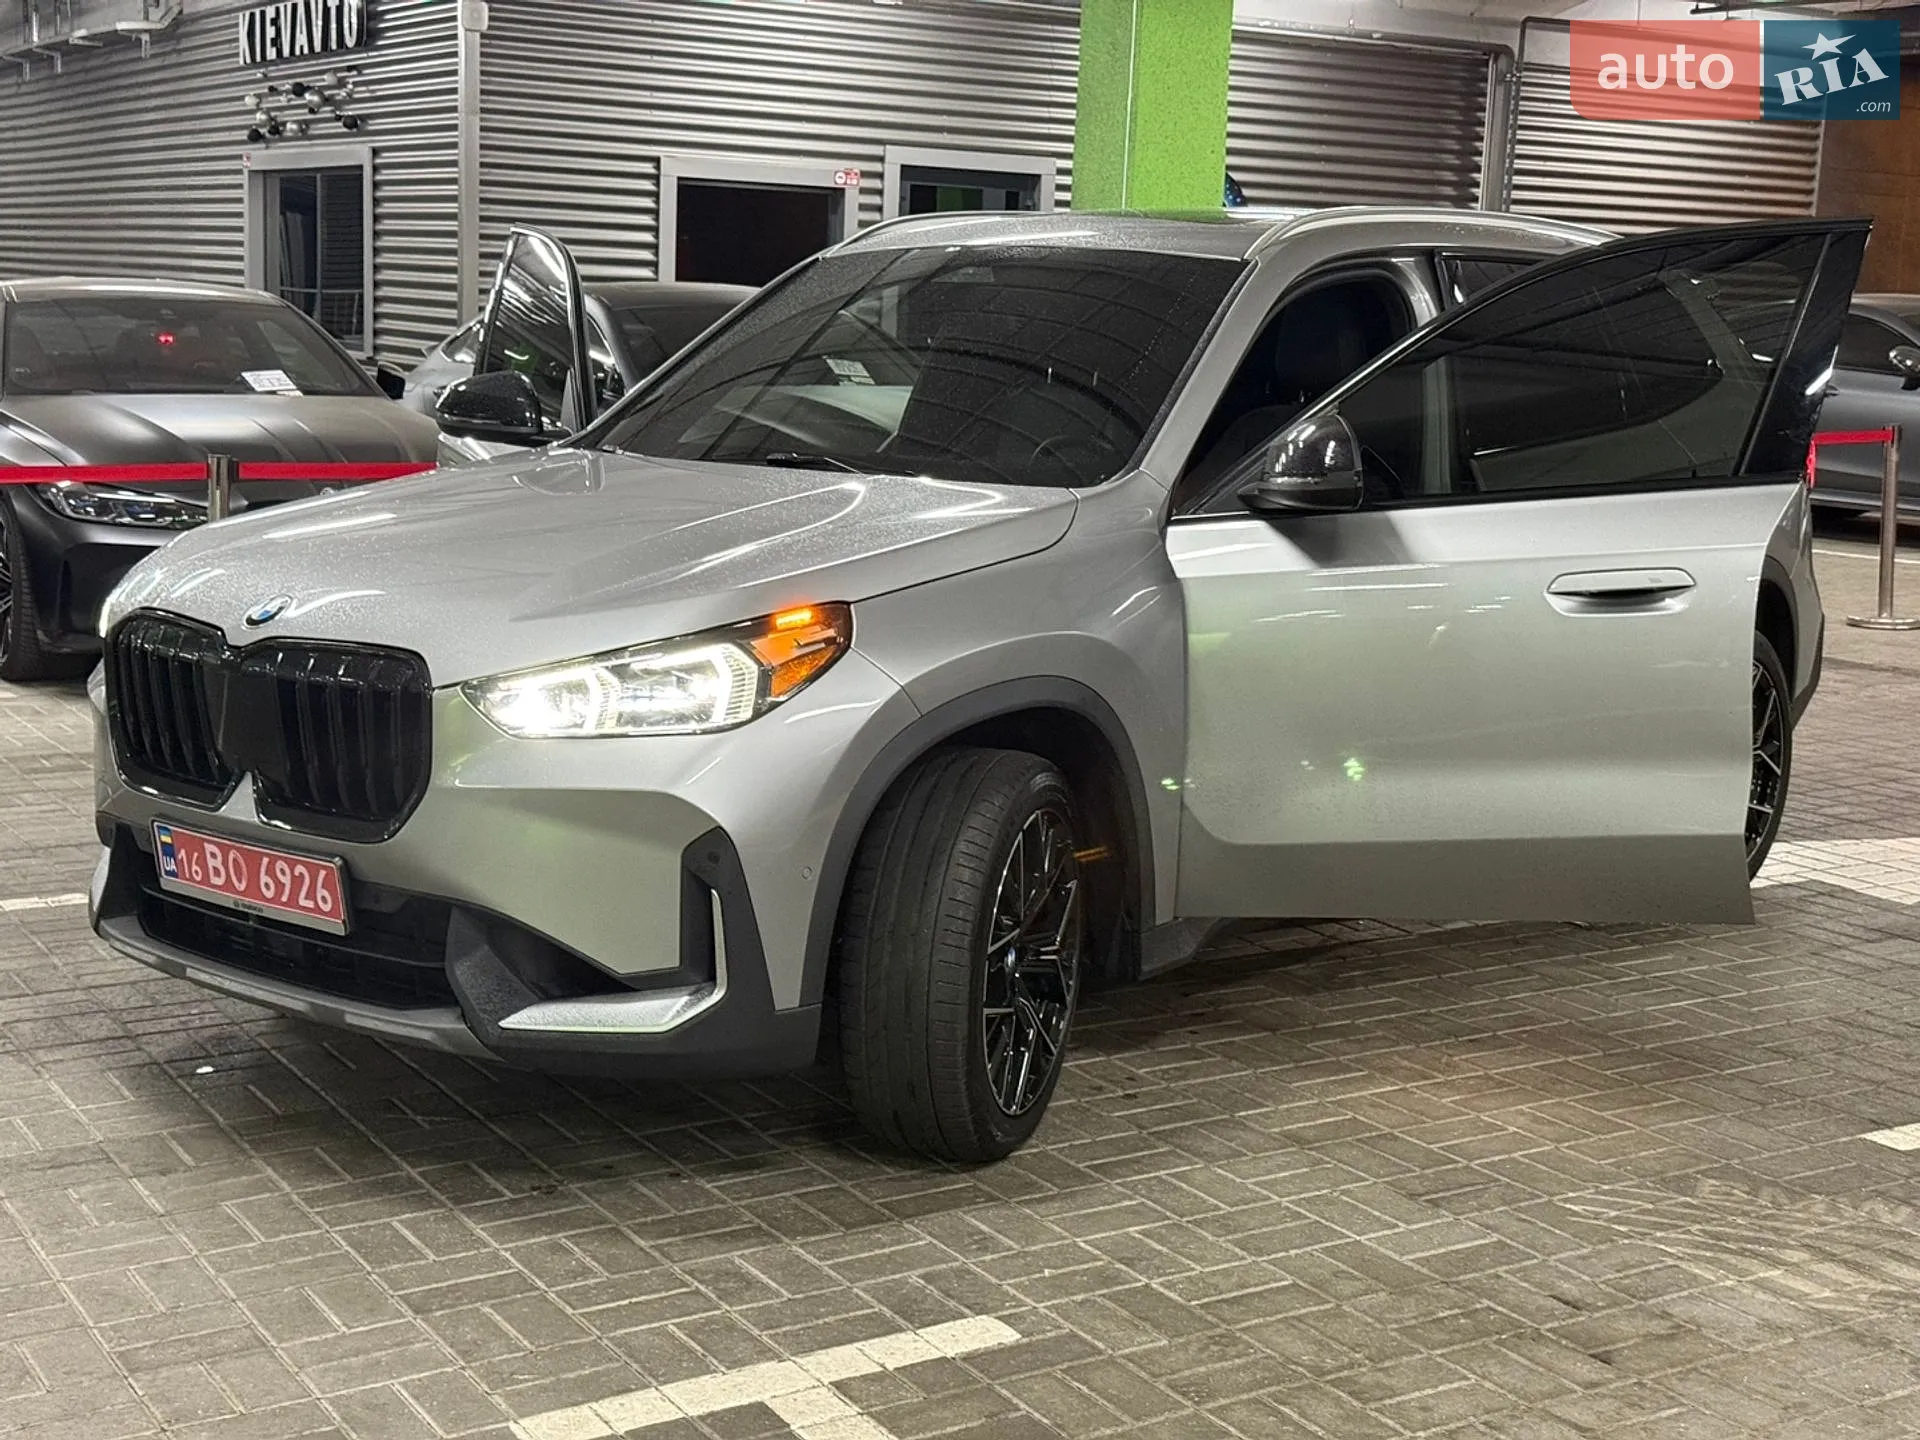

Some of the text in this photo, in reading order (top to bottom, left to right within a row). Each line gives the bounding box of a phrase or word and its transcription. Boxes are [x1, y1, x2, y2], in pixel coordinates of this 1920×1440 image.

[239, 0, 359, 65] KIEVAVTO
[163, 855, 177, 872] UA
[177, 843, 333, 913] 16 BO 6926
